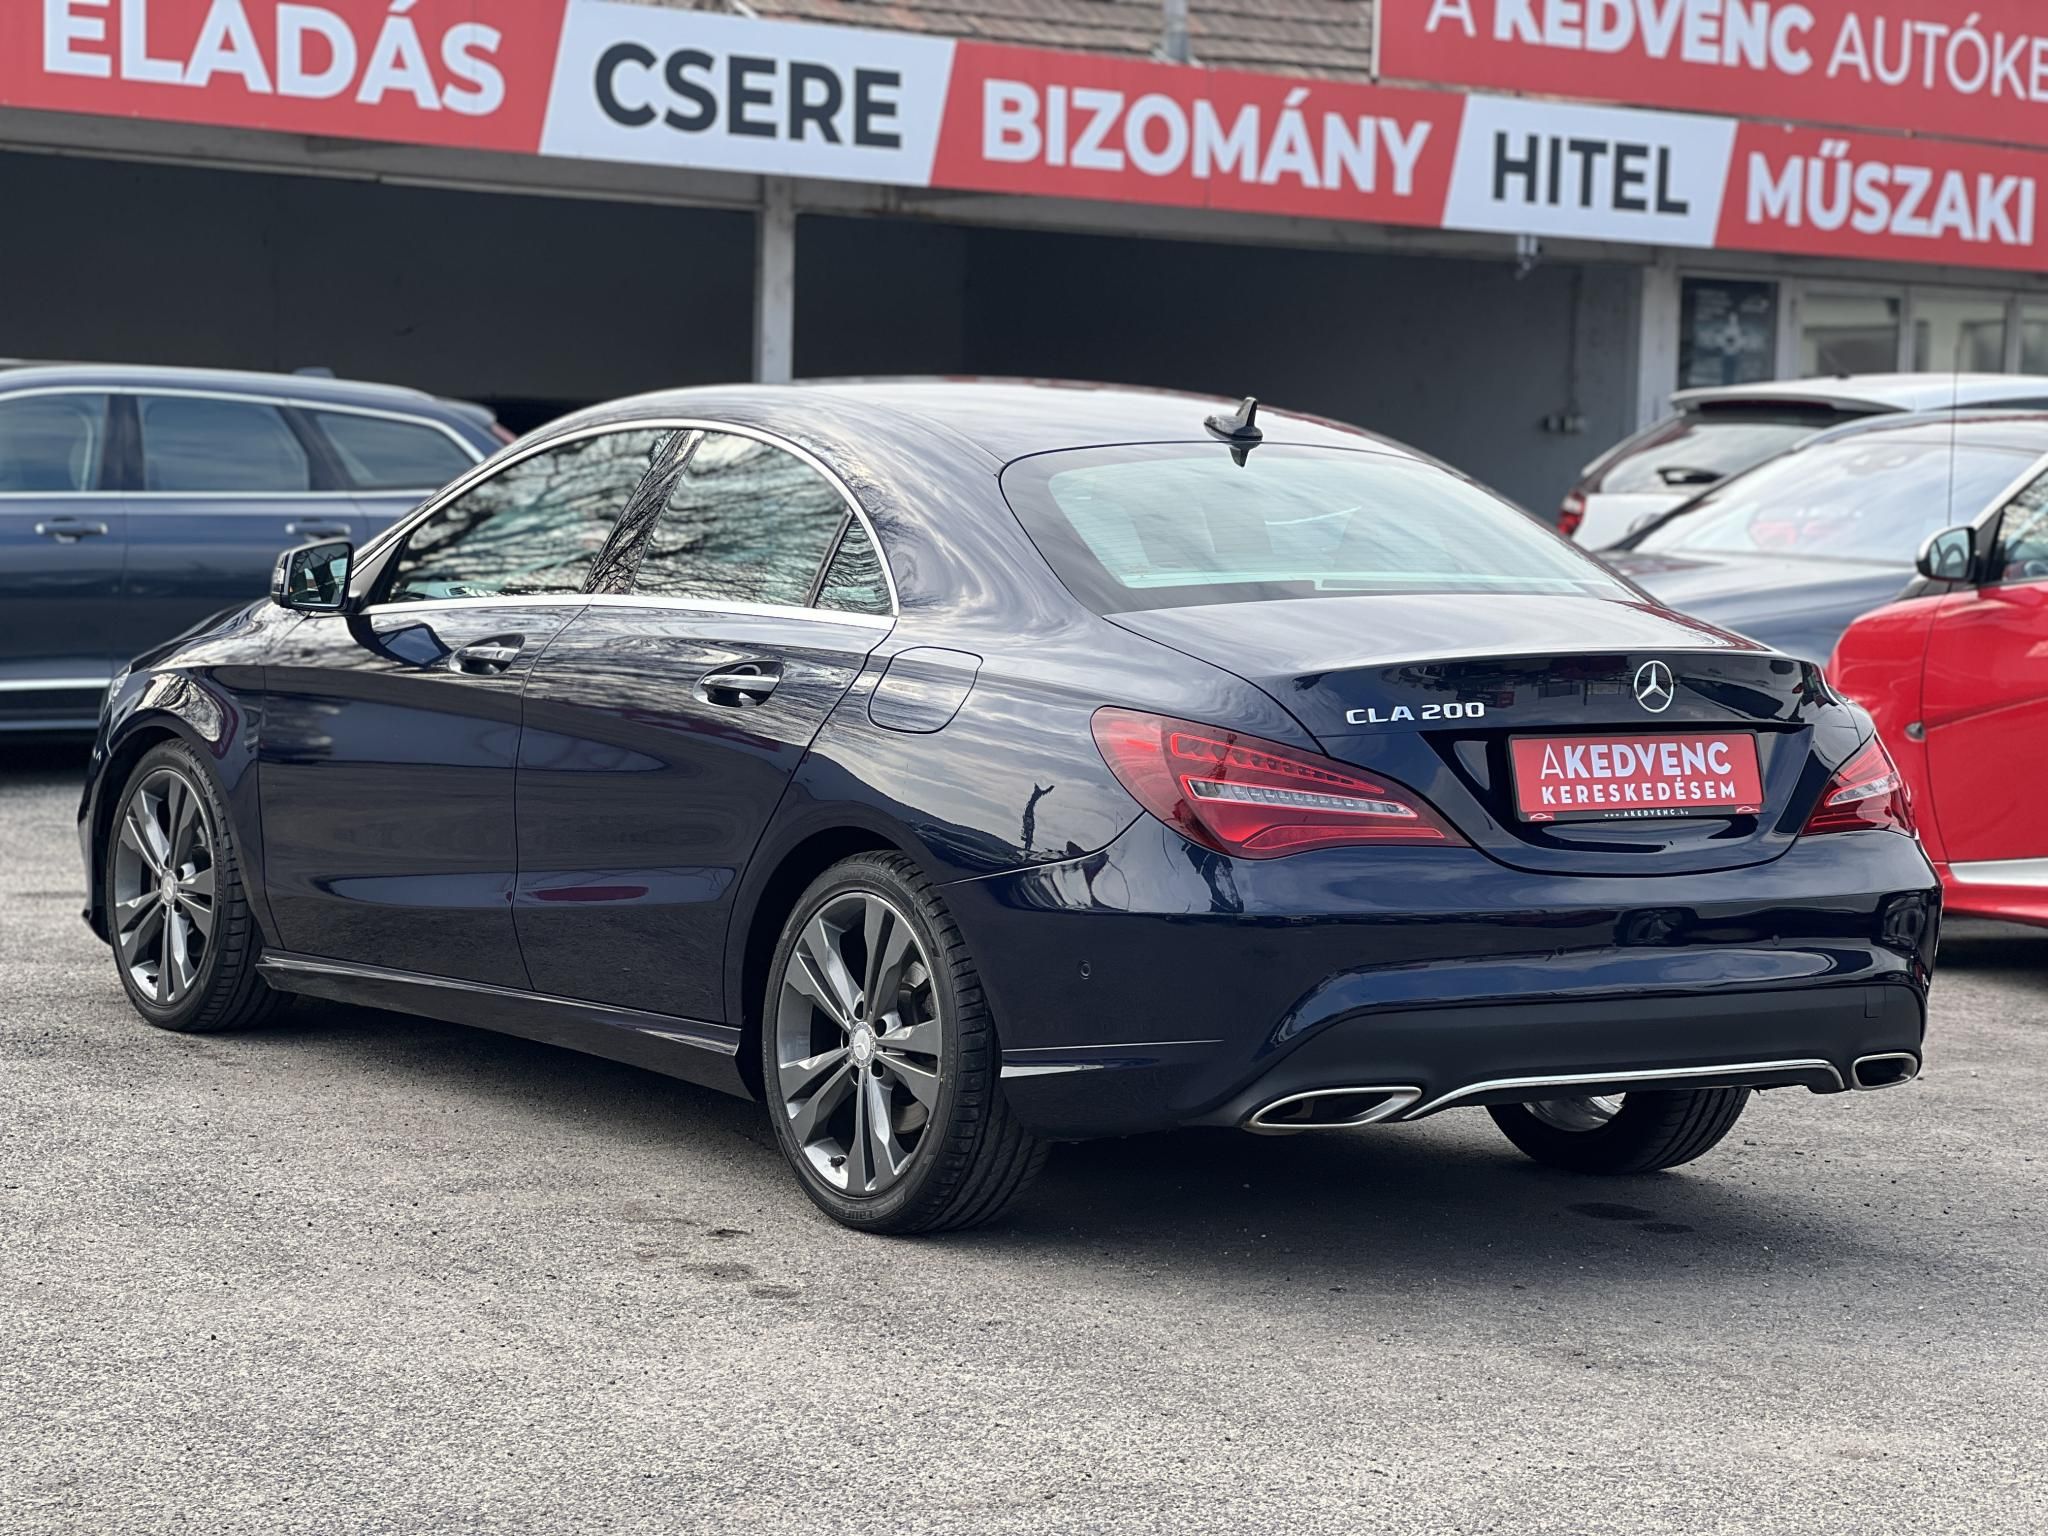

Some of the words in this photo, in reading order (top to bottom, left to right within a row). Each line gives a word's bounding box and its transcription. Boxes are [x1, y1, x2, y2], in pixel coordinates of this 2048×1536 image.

[1493, 0, 1815, 75] KEDVENC
[43, 0, 505, 116] ELADÁS
[594, 41, 902, 149] CSERE
[982, 78, 1433, 197] BIZOMÁNY
[1492, 131, 1690, 215] HITEL
[1746, 140, 2036, 245] MŰSZAKI
[1346, 705, 1415, 725] CLA
[1421, 702, 1485, 720] 200
[1540, 741, 1732, 780] AKEDVENC
[1541, 776, 1736, 805] KERESKEDÉSEM
